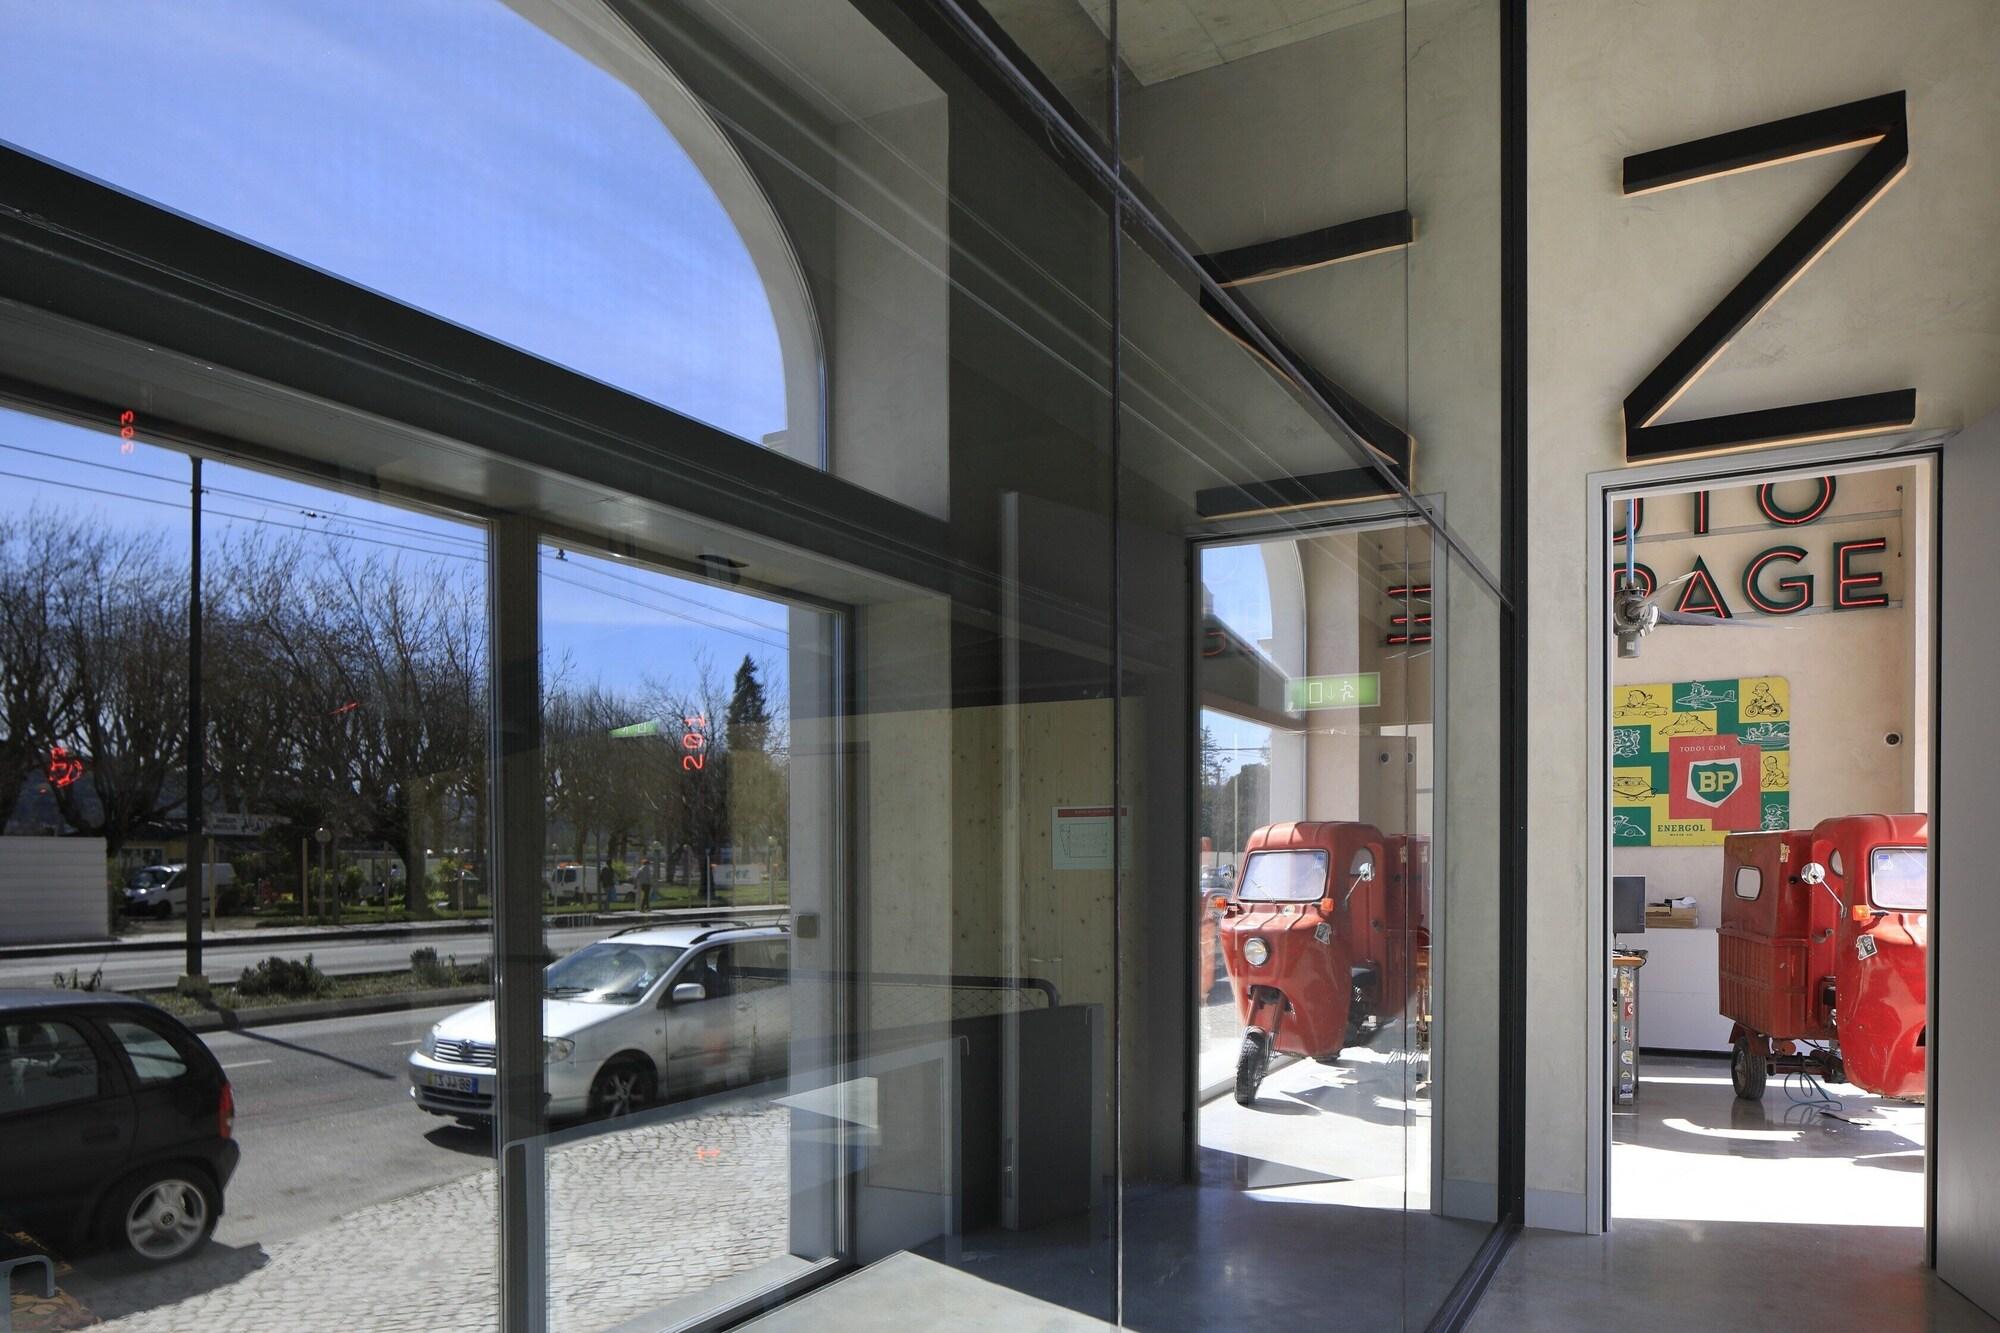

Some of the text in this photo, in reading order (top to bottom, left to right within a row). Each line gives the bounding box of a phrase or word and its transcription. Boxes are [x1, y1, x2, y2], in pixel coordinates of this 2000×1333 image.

[1623, 90, 1917, 465] Z
[682, 713, 706, 771] 201
[1698, 770, 1735, 793] BP
[1657, 824, 1706, 832] ENERGOL
